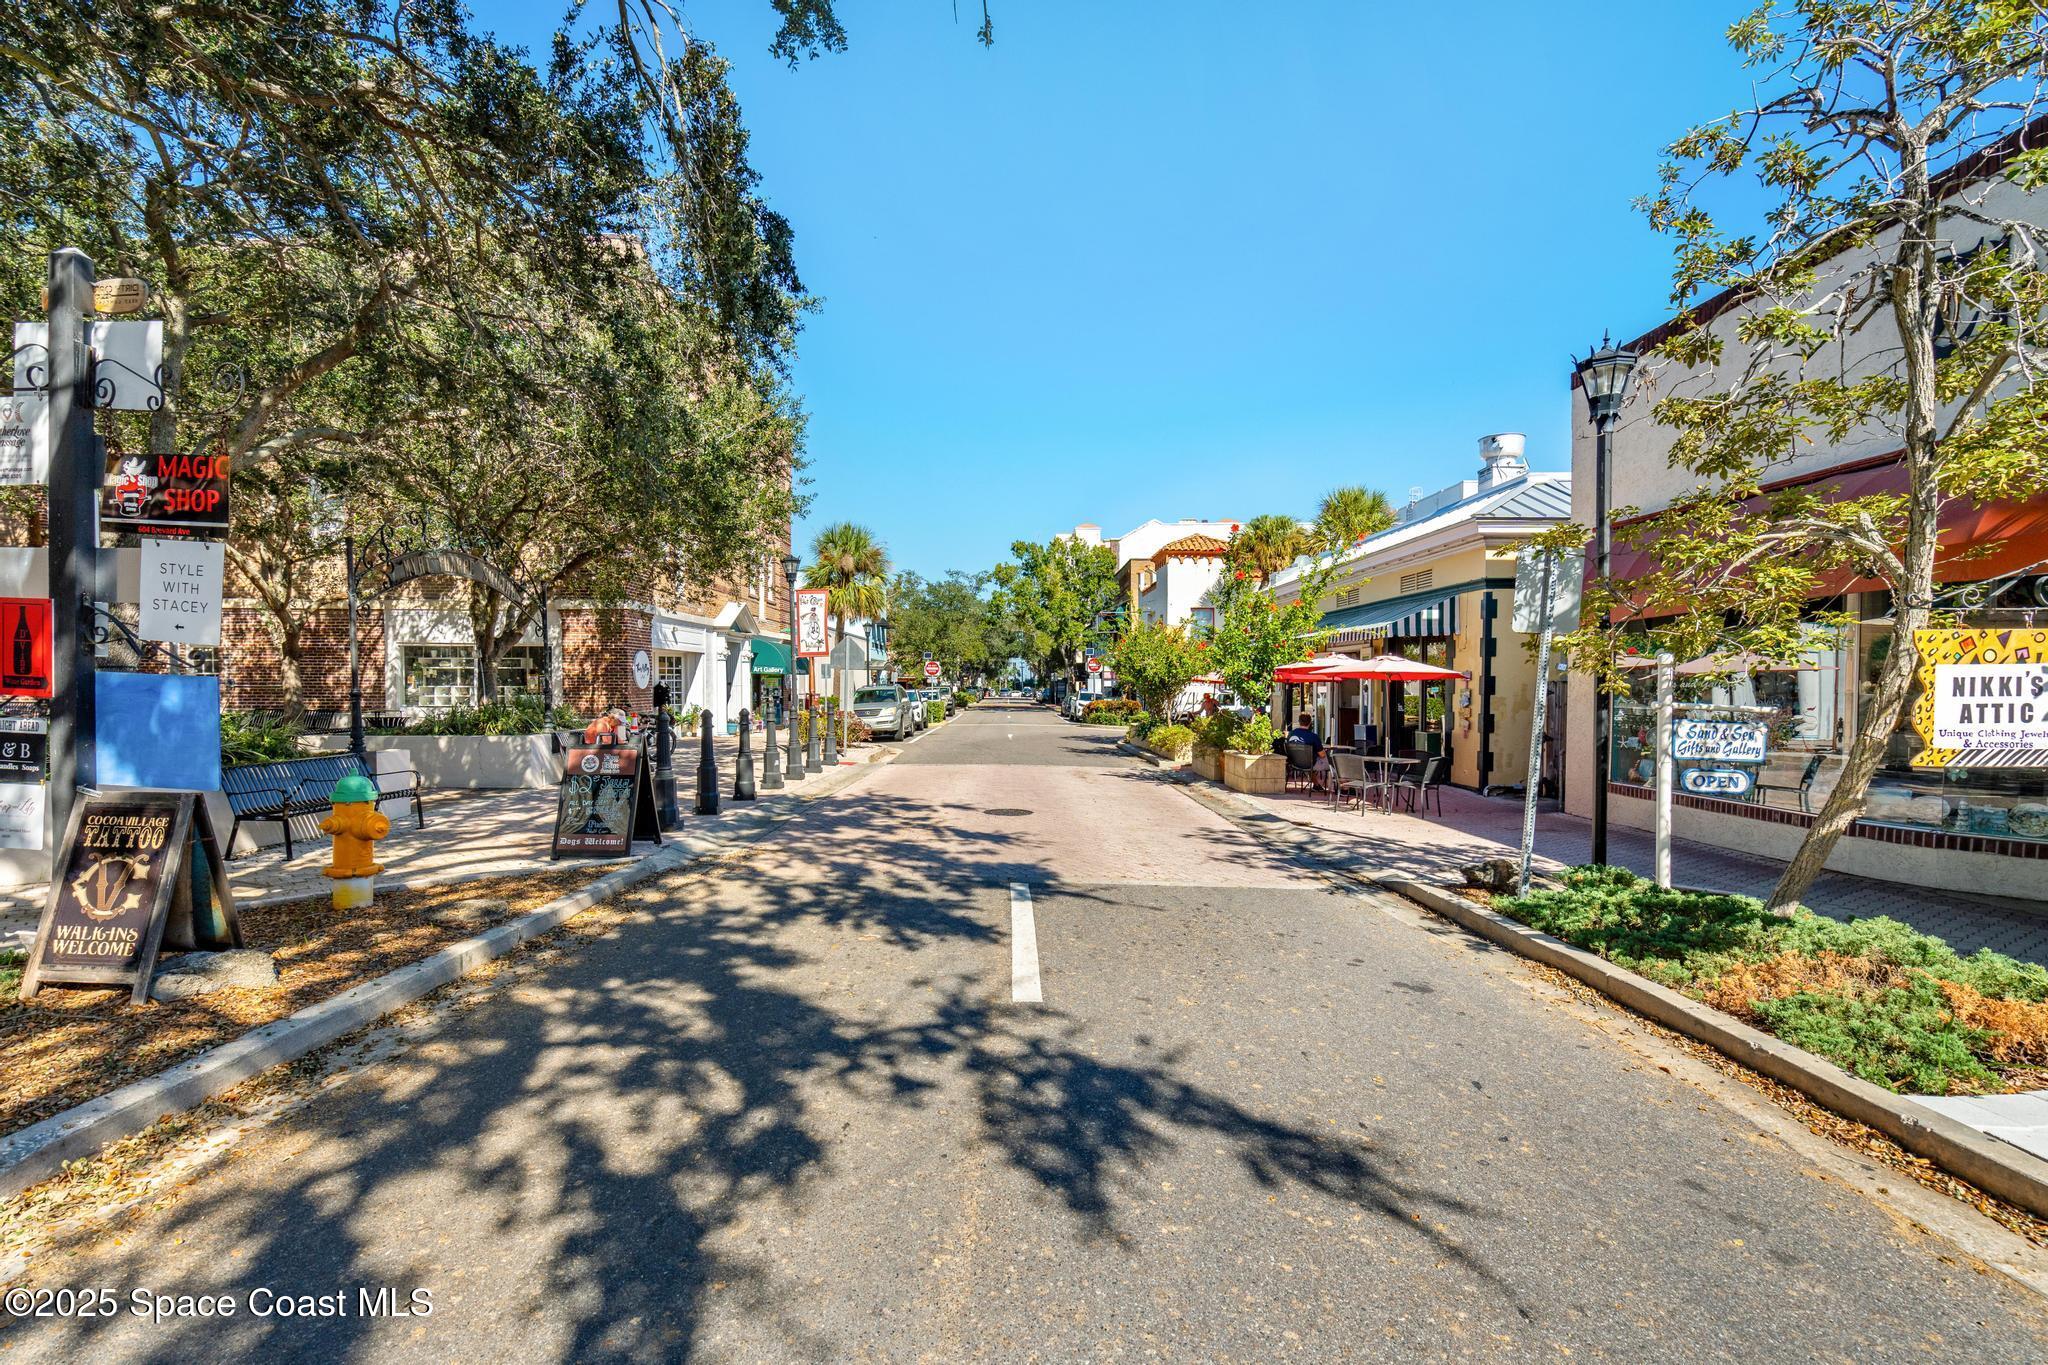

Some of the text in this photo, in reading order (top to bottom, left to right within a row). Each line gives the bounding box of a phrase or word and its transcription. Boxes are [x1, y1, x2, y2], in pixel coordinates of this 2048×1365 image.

[158, 455, 230, 479] MAGIC
[105, 473, 158, 489] Magic Shop
[163, 488, 220, 512] SHOP
[151, 525, 177, 535] Brevard
[178, 526, 191, 535] Ave
[160, 562, 204, 577] STYLE
[163, 581, 200, 595] WITH
[152, 598, 208, 614] STACEY
[764, 666, 784, 674] Gallery
[1952, 671, 2044, 697] NIKKI'S
[1959, 703, 2034, 724] ATTIC
[19, 720, 40, 732] AHEAD
[1686, 725, 1718, 739] Sand
[1719, 729, 1729, 740] &
[1939, 729, 1974, 739] Unique
[1977, 728, 2016, 739] Clothing
[3, 742, 30, 758] & B
[1677, 740, 1762, 758] Gifts and Gallery
[1963, 738, 2034, 748] & Accessories
[22, 764, 40, 772] Soaps
[1692, 775, 1740, 789] OPEN
[88, 815, 170, 828] COCOA VILLAGE
[83, 825, 165, 850] TATTOO
[560, 837, 624, 846] Dogs Welcome!
[56, 925, 139, 942] WALK-INS
[53, 939, 136, 957] WELCOME
